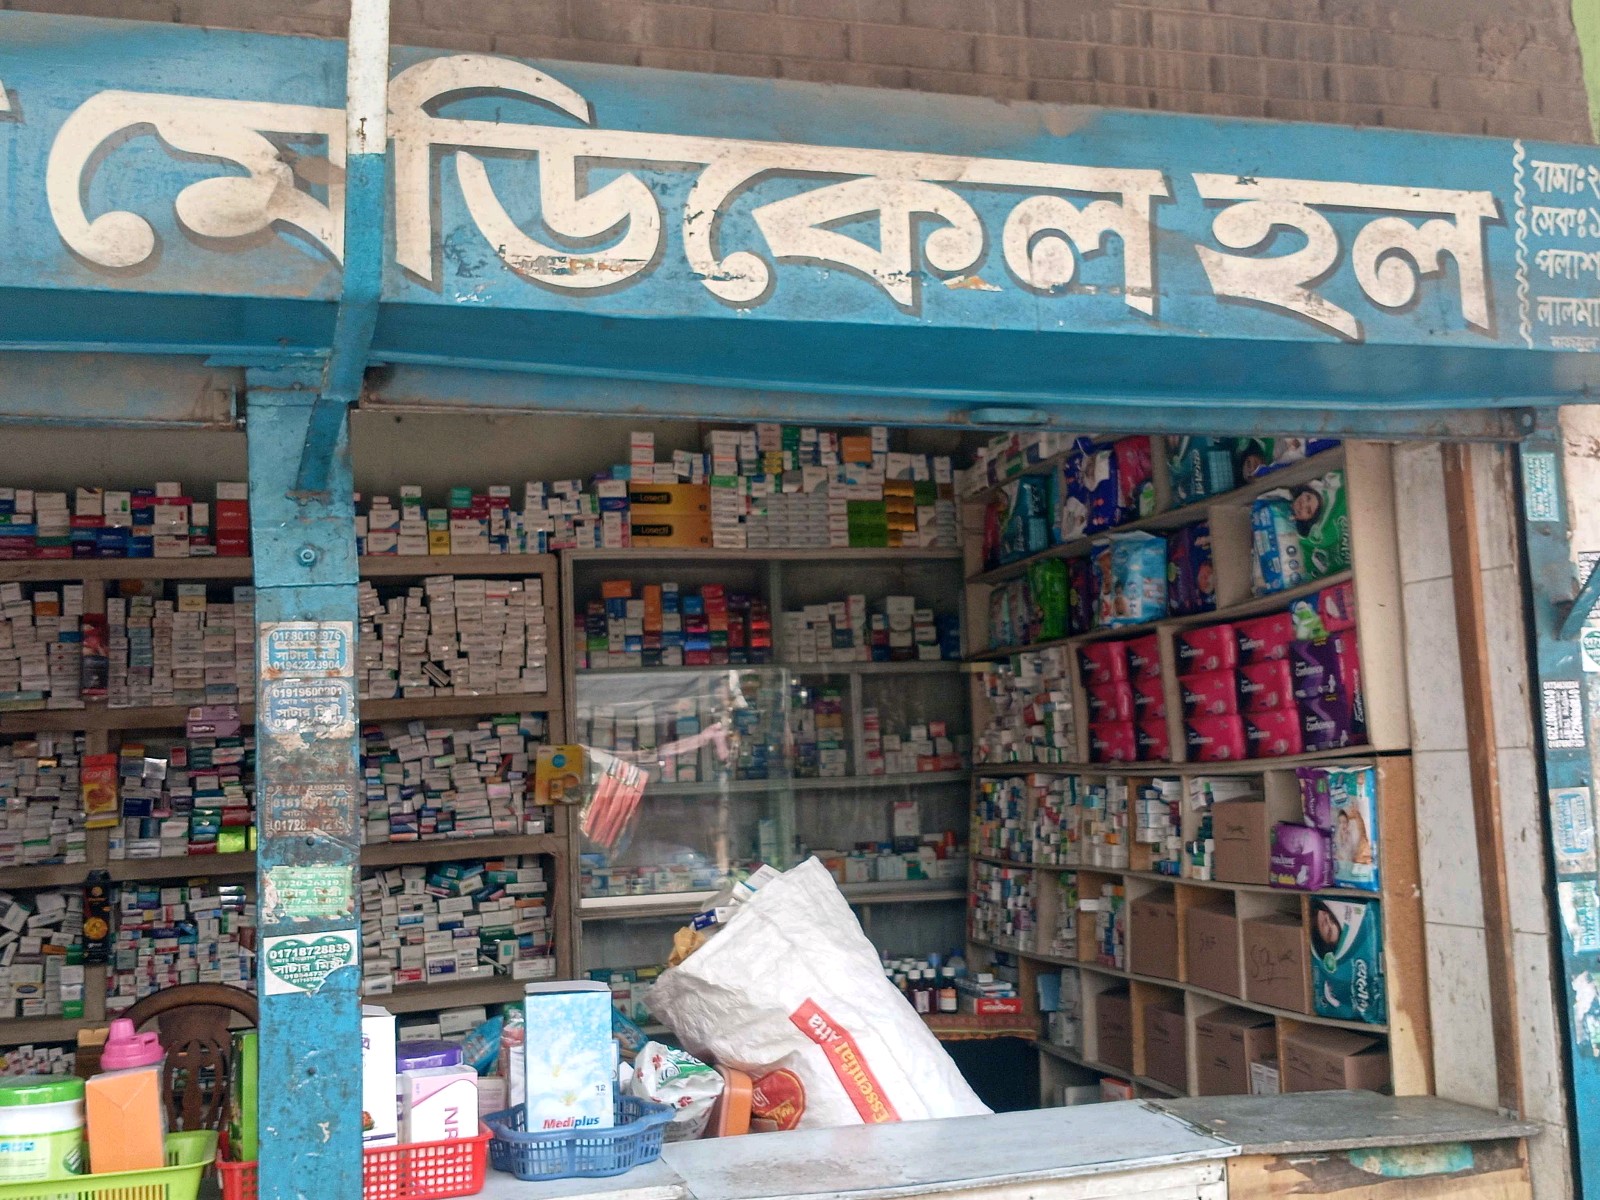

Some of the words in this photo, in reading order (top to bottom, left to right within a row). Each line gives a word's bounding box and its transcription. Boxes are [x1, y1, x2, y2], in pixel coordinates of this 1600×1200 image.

[46, 54, 1170, 318] মেডিকেল
[1192, 172, 1502, 343] হল
[269, 943, 351, 959] 01718728839
[808, 1013, 842, 1042] Atta
[834, 1041, 890, 1122] Essential
[543, 1115, 600, 1129] Mediplus
